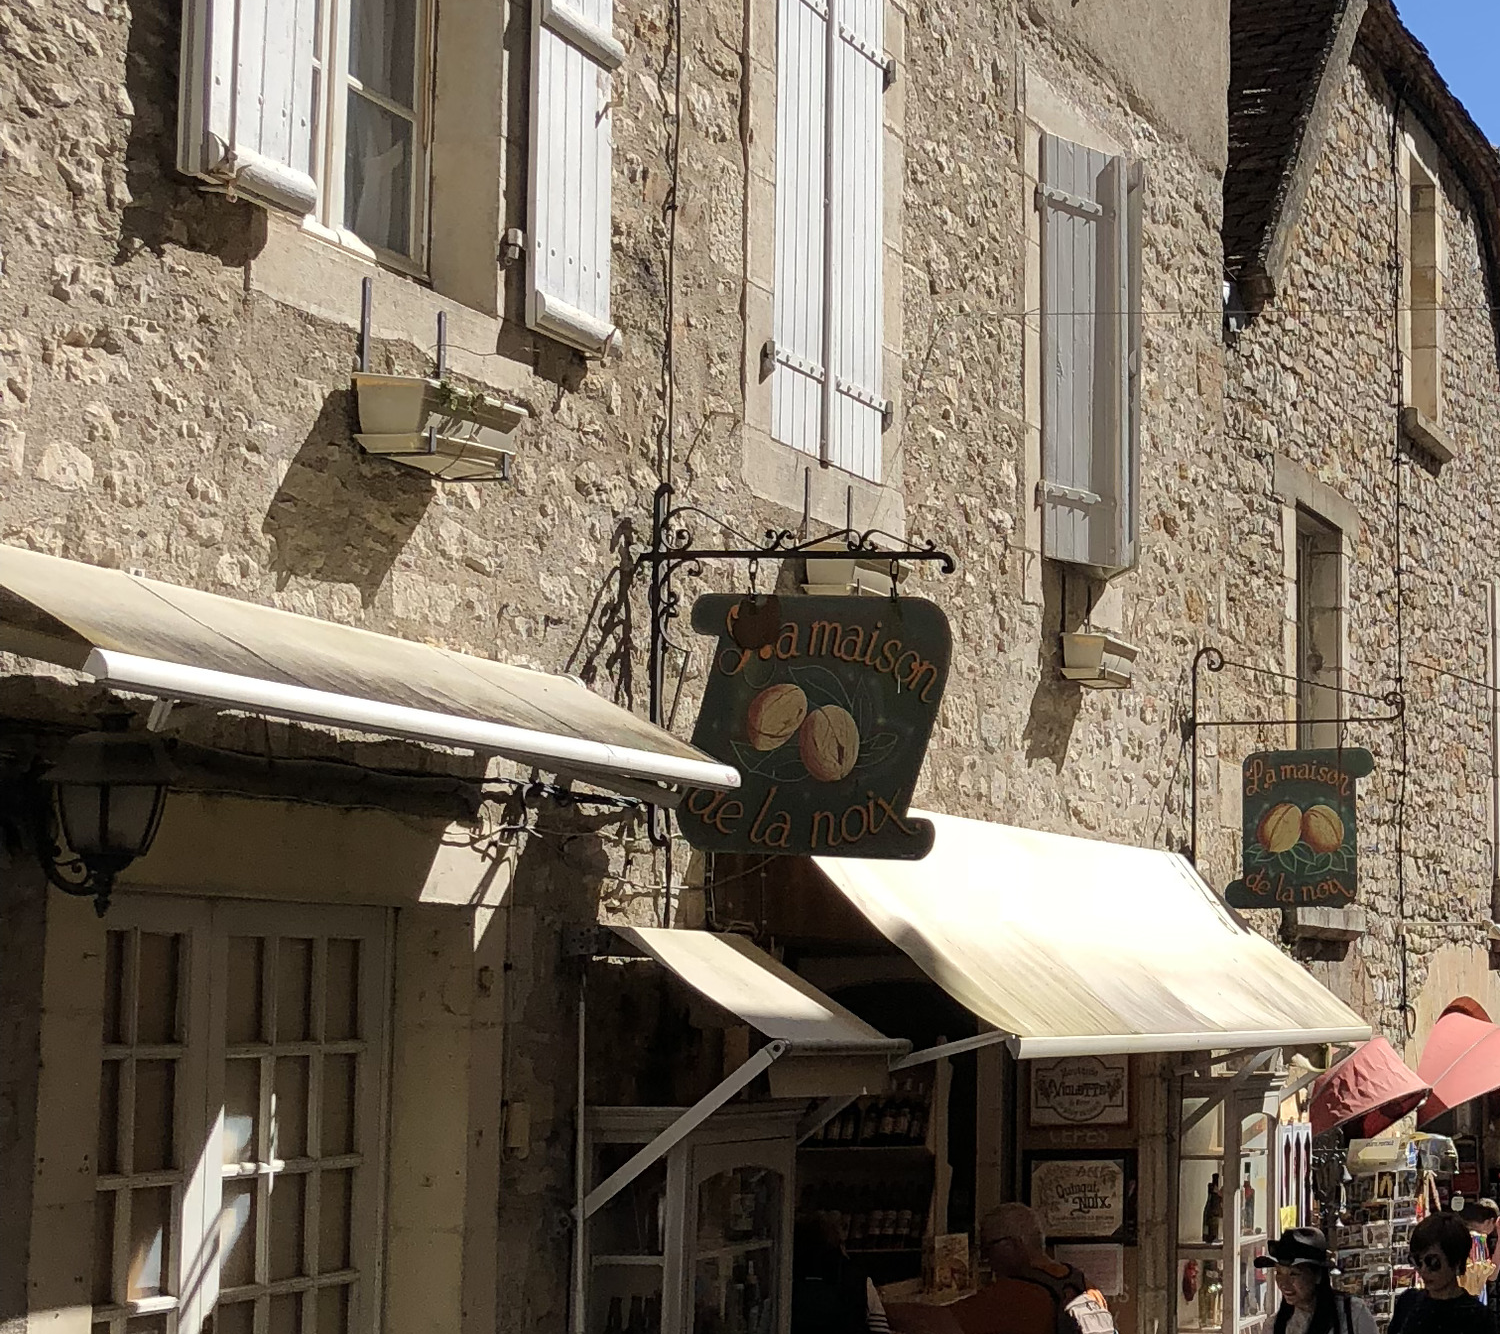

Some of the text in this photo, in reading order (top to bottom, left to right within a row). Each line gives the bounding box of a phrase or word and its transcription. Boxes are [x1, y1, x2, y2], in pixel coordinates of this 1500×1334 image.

[809, 619, 938, 704] maison
[1245, 758, 1350, 796] La maison
[749, 785, 791, 848] la
[811, 788, 922, 848] noix
[1246, 867, 1271, 895] de
[1275, 872, 1295, 902] la
